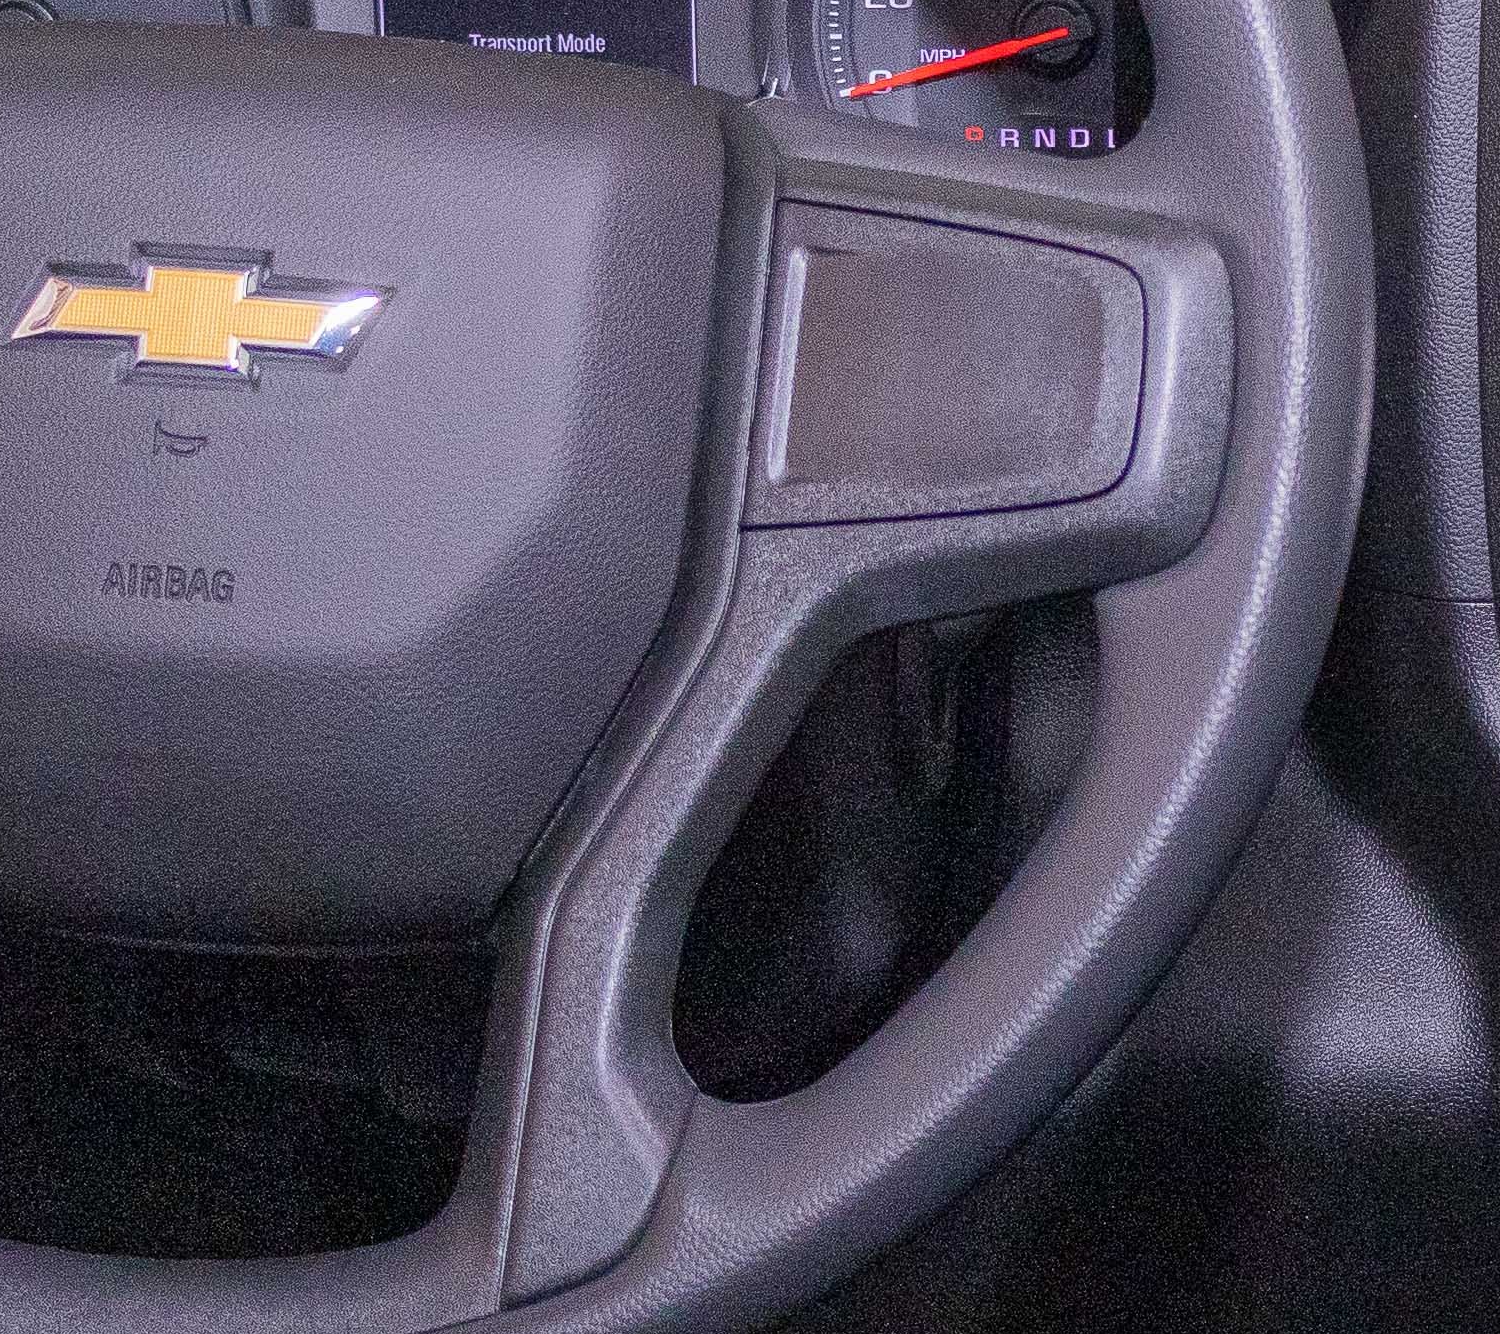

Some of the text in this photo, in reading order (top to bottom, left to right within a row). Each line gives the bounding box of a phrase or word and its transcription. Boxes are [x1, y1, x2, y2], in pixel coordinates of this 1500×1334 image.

[469, 33, 606, 53] Transport Mode
[1000, 128, 1020, 148] R
[1034, 128, 1056, 148] N
[1069, 128, 1090, 148] D
[102, 563, 237, 604] AIRBAG
